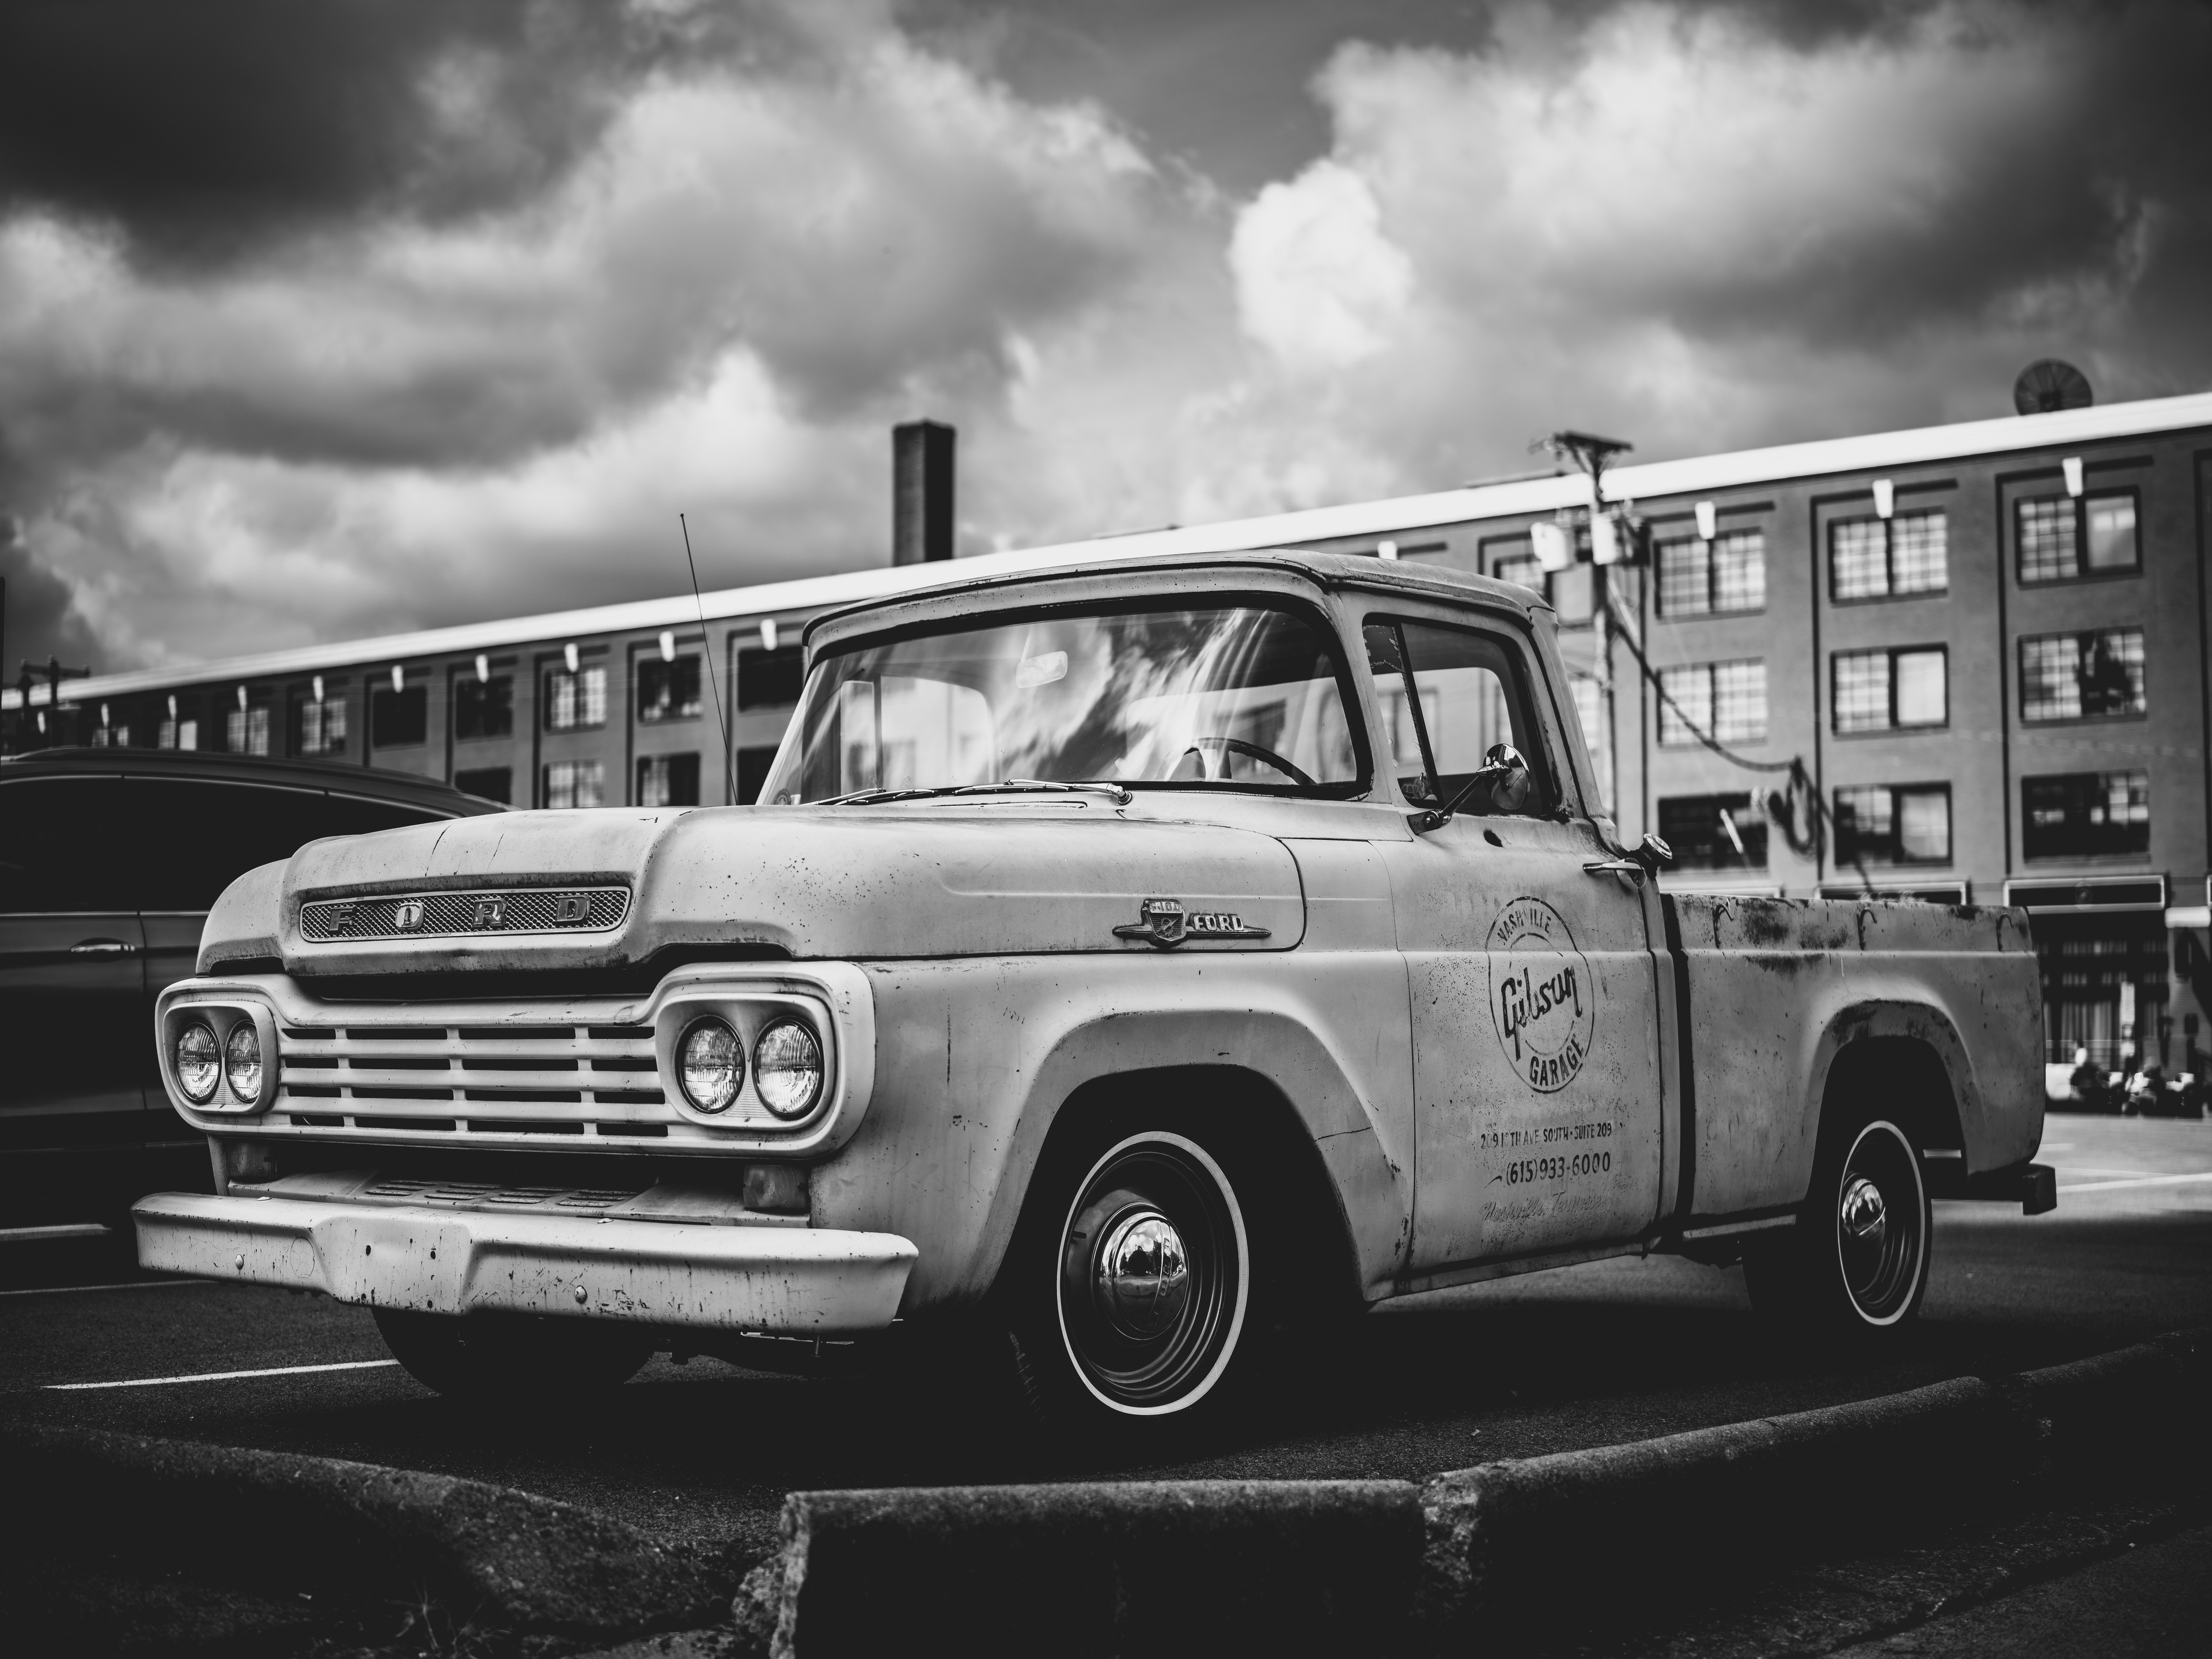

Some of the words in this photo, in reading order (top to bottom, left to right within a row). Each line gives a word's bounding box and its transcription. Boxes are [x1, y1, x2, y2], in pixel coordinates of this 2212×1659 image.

[328, 894, 591, 934] FORD
[1191, 914, 1244, 931] FORD
[1497, 908, 1551, 945] NASHVILLE
[1501, 965, 1582, 1062] Gibson
[1529, 1034, 1584, 1086] GARAGE
[1543, 1126, 1569, 1143] SOUTH
[1574, 1123, 1595, 1140] SUITE
[1597, 1122, 1612, 1137] 209
